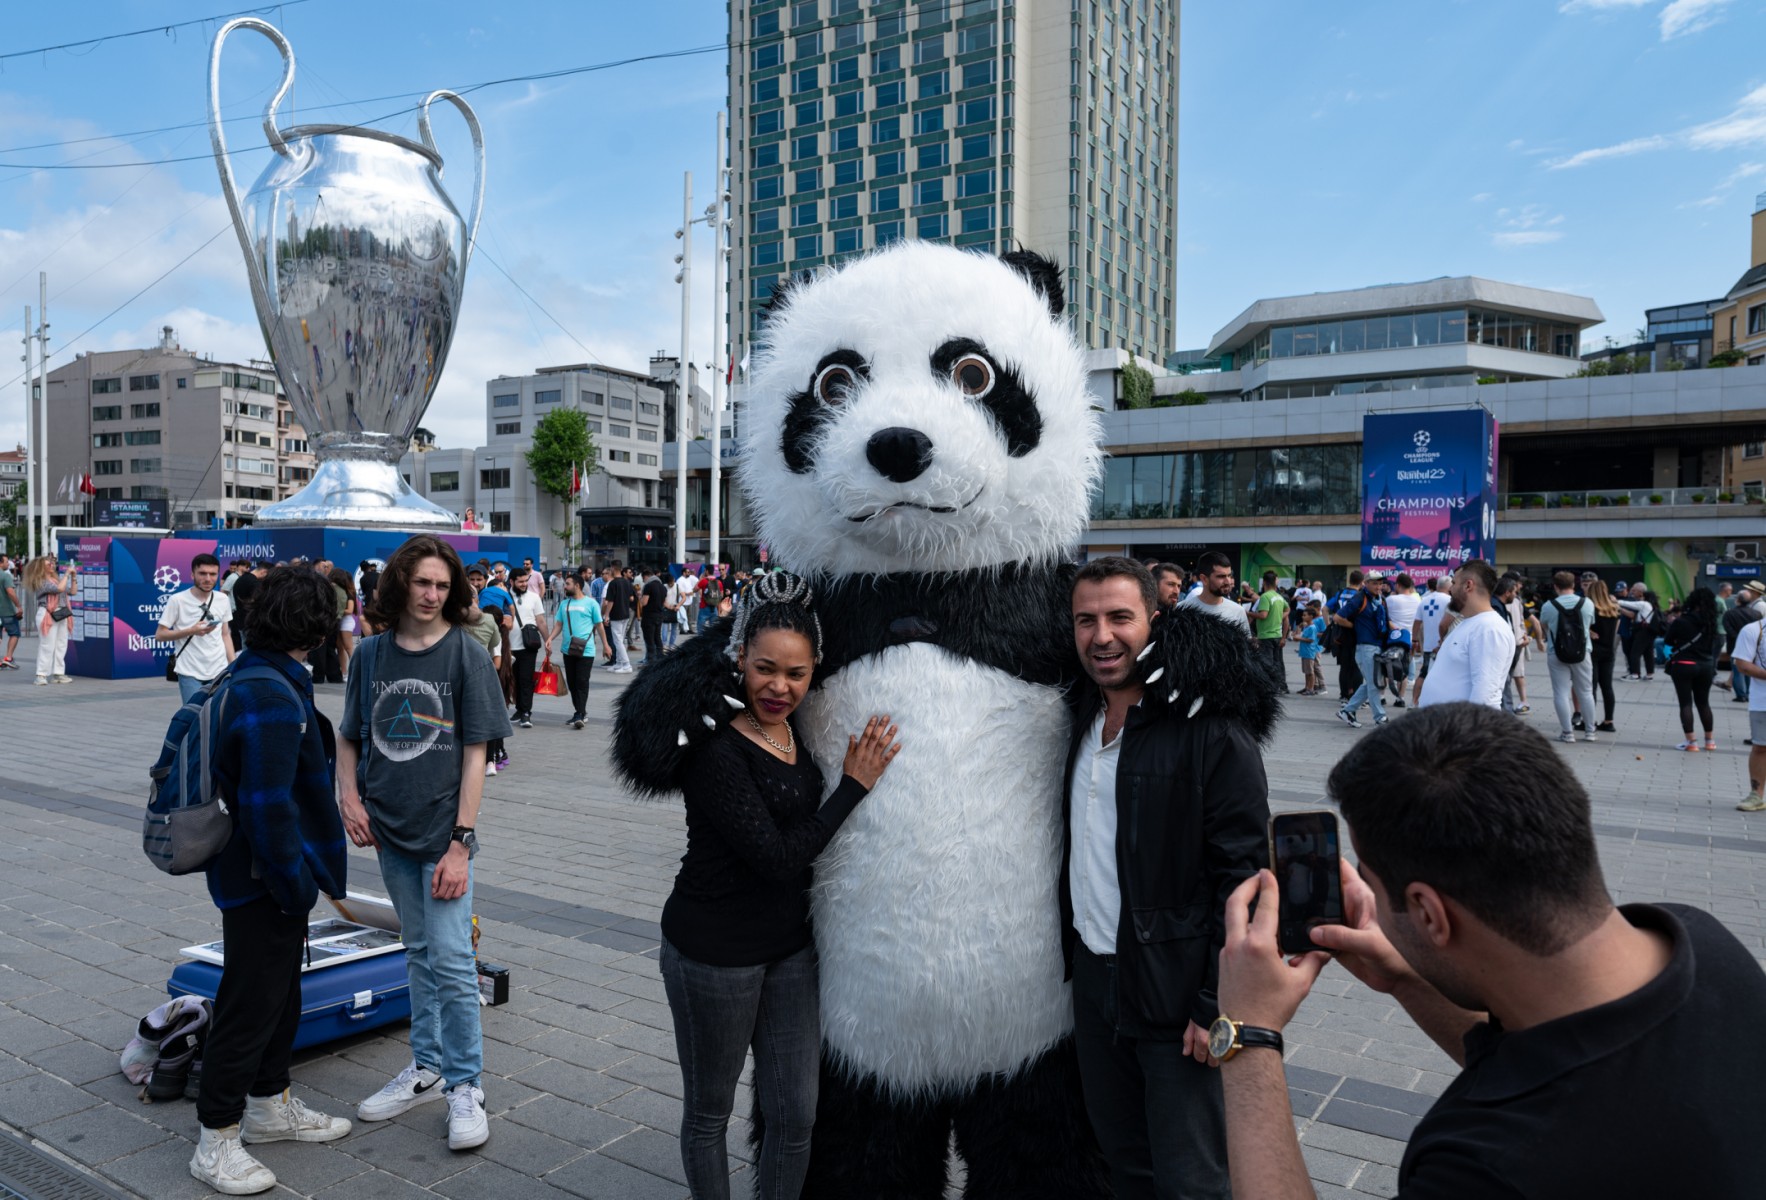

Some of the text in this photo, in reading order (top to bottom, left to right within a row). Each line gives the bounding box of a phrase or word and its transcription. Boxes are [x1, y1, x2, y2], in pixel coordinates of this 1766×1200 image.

[354, 262, 389, 279] DES
[1378, 497, 1466, 510] CHAMPIONS
[219, 543, 275, 558] CHAMPIONS
[1370, 545, 1432, 560] ÜCRETSİZ
[1410, 568, 1446, 577] Festival
[404, 680, 453, 696] FLOYD
